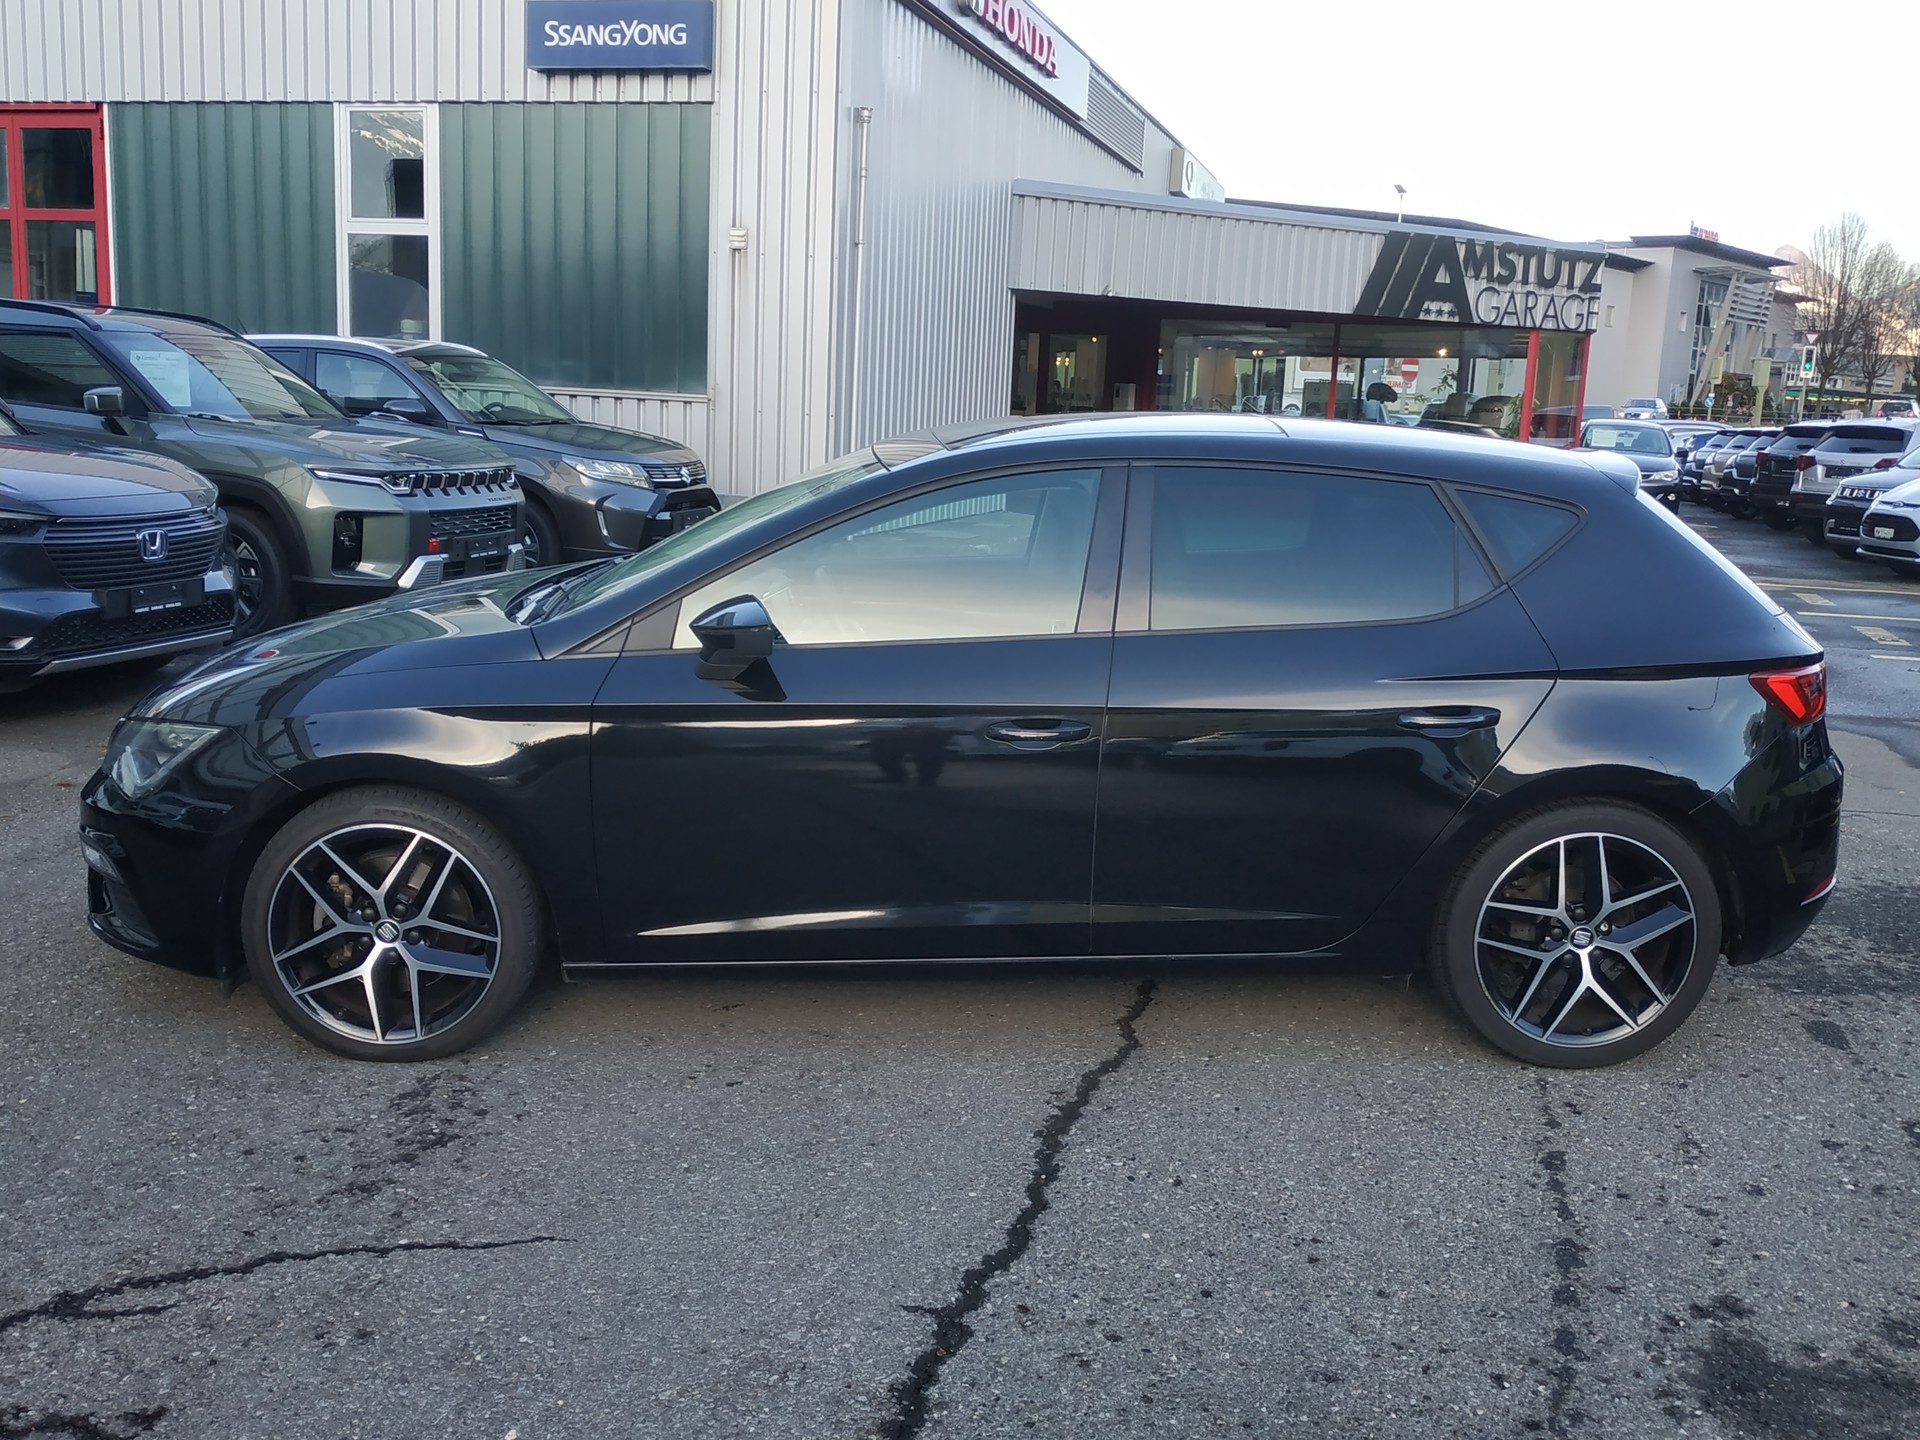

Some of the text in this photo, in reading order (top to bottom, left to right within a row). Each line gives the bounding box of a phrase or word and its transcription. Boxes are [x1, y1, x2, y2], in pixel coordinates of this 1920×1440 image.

[984, 0, 1058, 77] HONDA
[1401, 234, 1607, 323] AMSTUTZ
[1475, 286, 1600, 333] GARAGE
